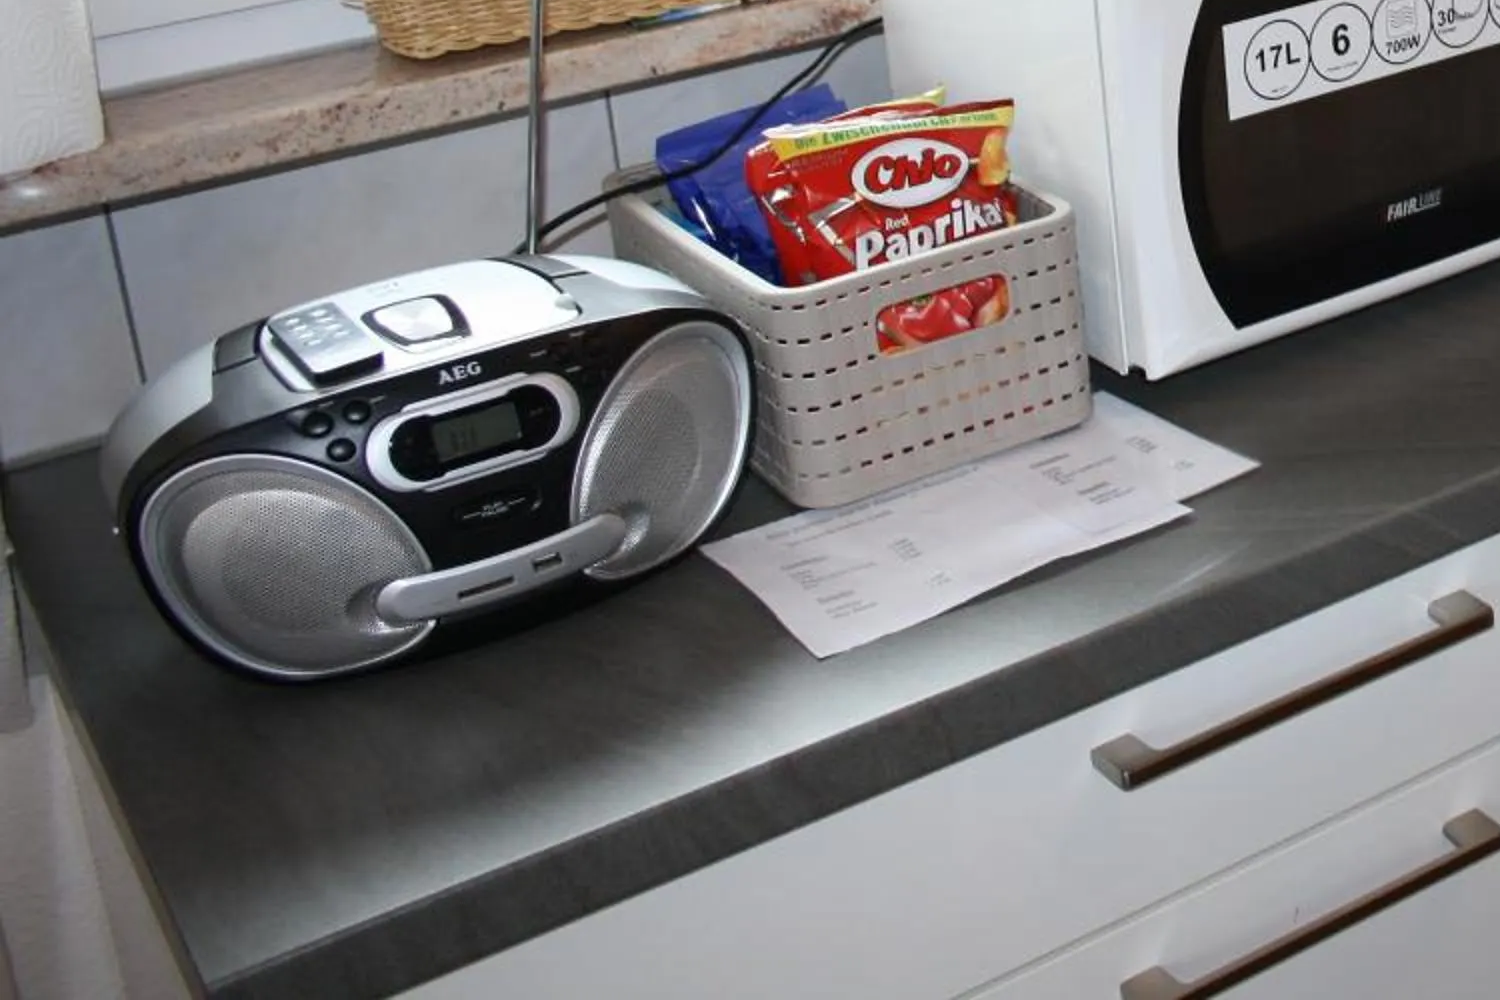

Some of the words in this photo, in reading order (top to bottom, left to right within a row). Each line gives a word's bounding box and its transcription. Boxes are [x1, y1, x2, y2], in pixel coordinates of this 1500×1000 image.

[1437, 7, 1456, 27] 30
[1332, 23, 1351, 57] 6
[1385, 33, 1421, 55] 700W
[1255, 42, 1301, 73] 17L
[856, 198, 1004, 271] Paprika
[438, 361, 482, 386] AEG
